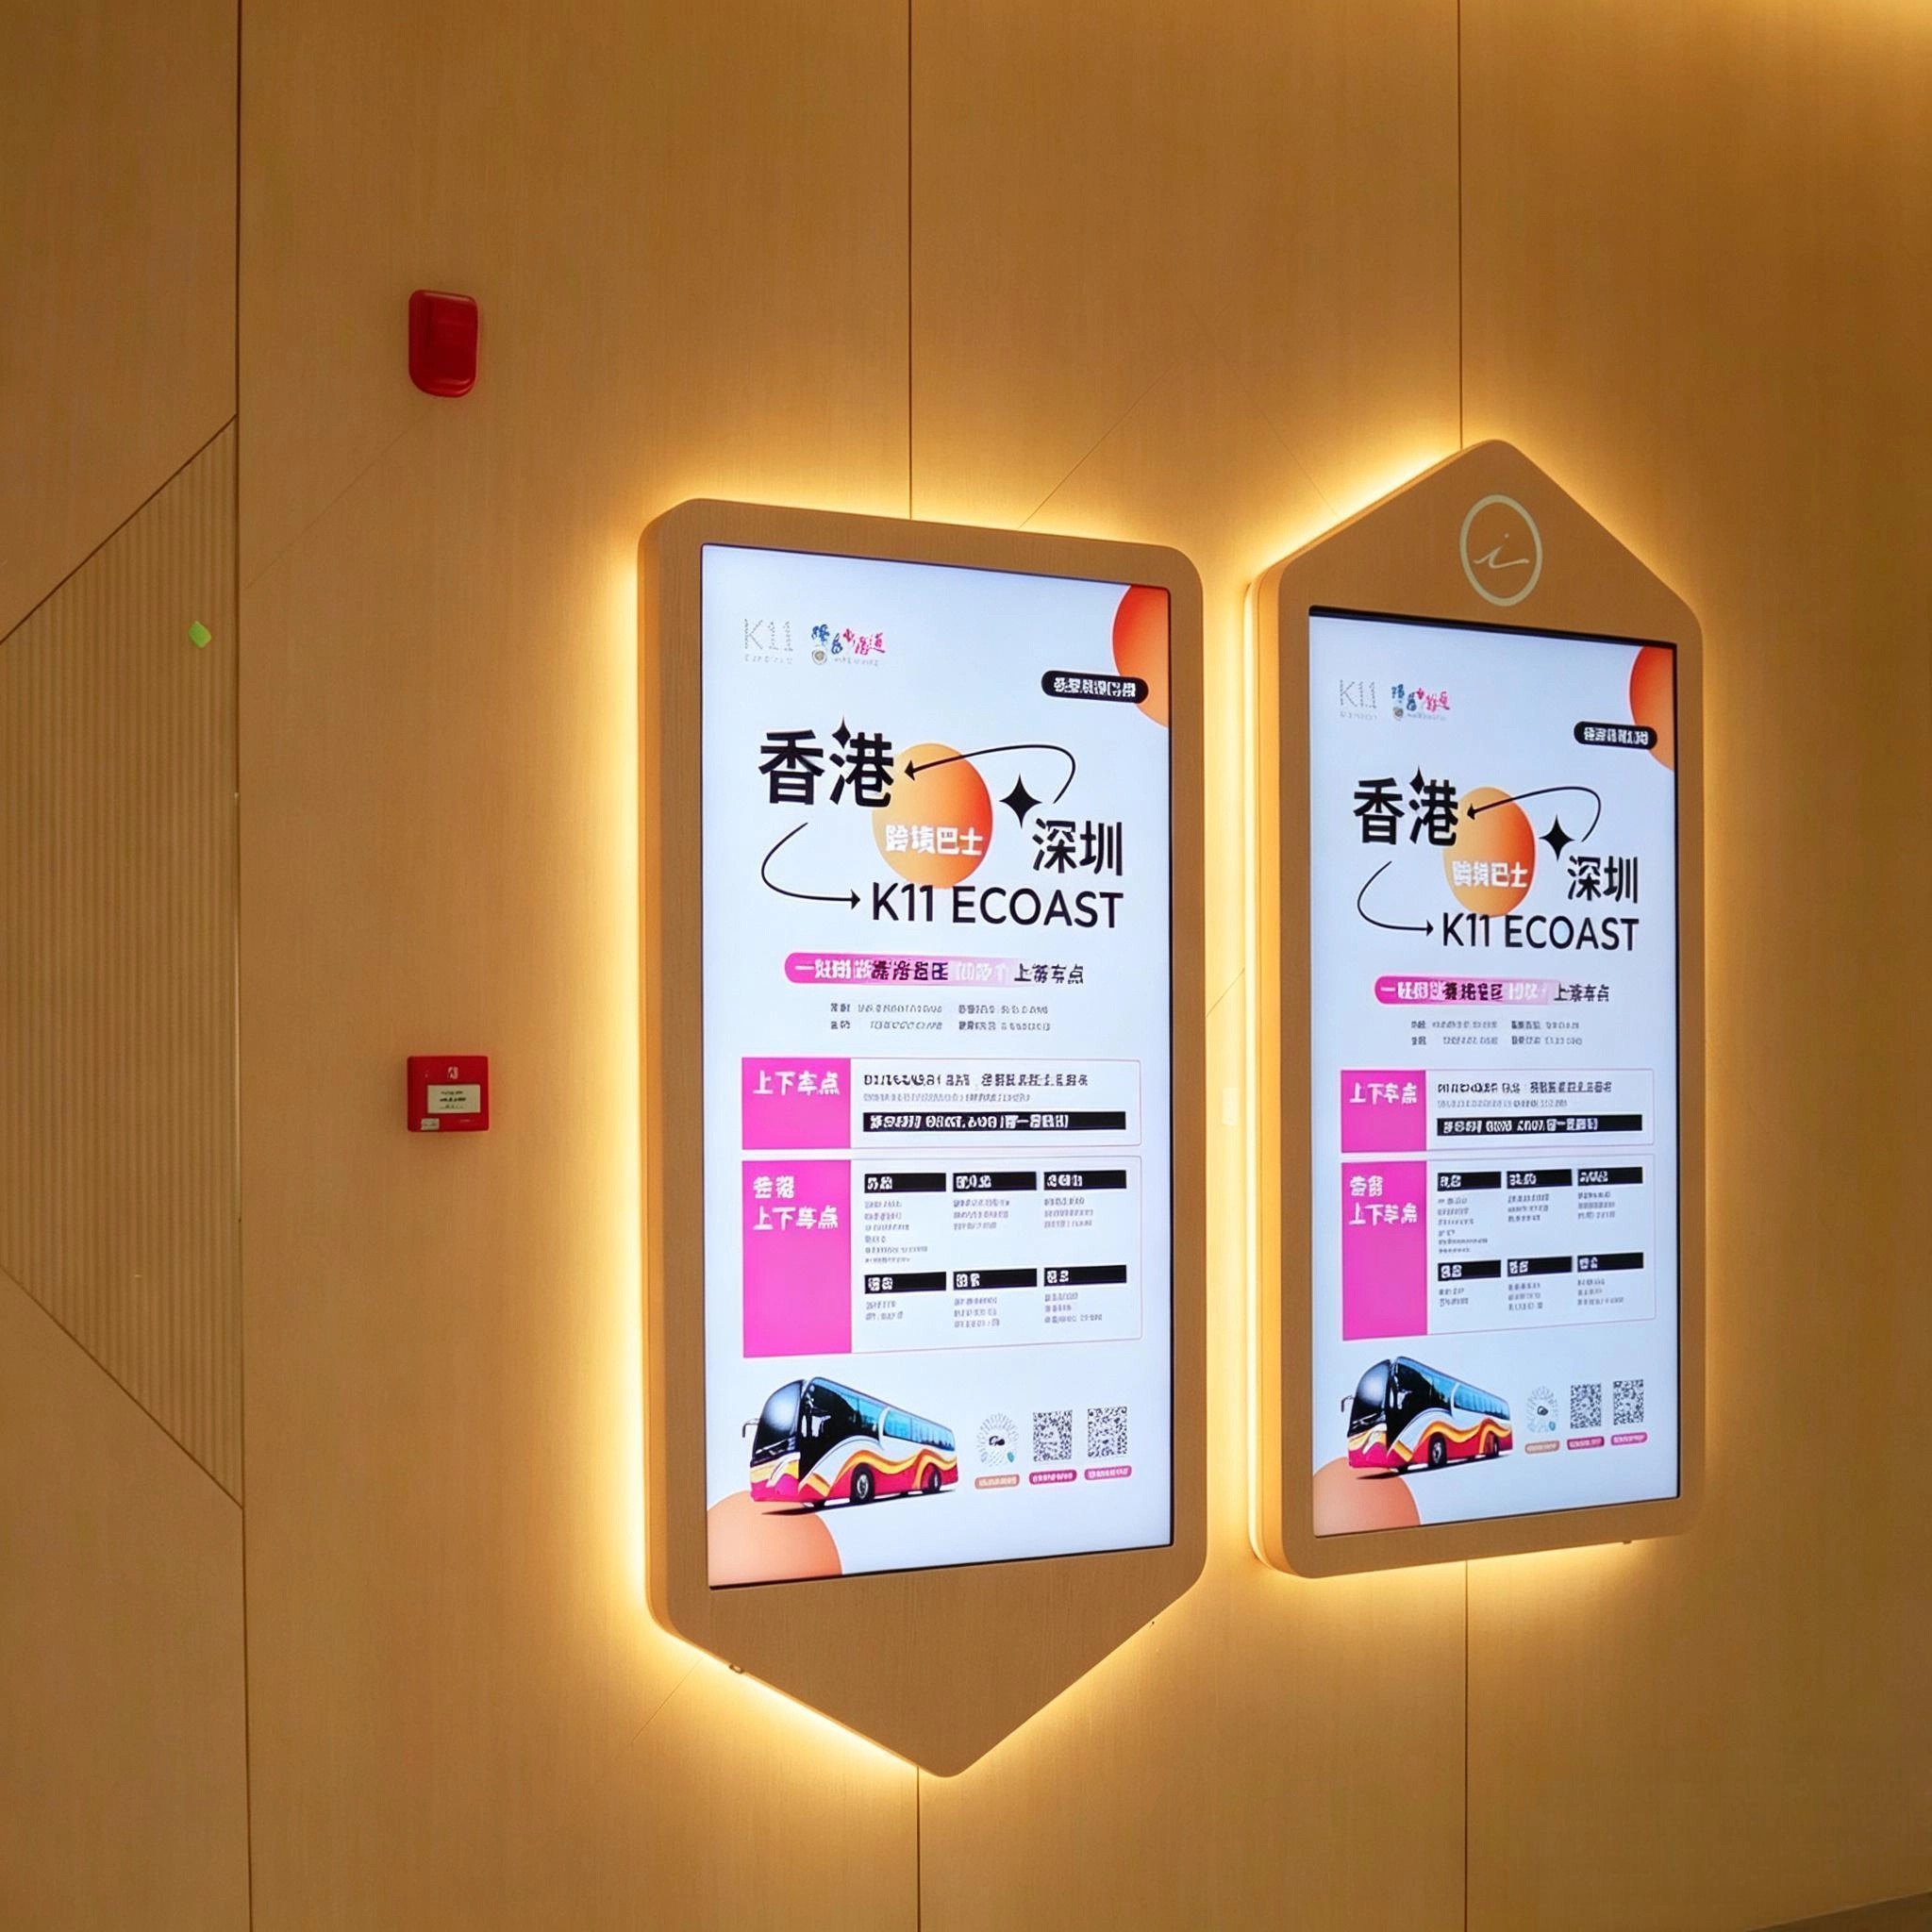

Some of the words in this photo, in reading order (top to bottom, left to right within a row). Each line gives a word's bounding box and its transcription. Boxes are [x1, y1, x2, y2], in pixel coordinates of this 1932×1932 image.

[743, 618, 794, 652] K11
[758, 729, 894, 808] 香港
[1353, 776, 1458, 846] 香港
[1032, 818, 1124, 876] 深圳
[1567, 855, 1639, 904] 深圳
[873, 881, 933, 922] K11
[953, 885, 1124, 928] ECOAST
[1443, 912, 1491, 947] K11
[1505, 914, 1640, 951] ECOAST
